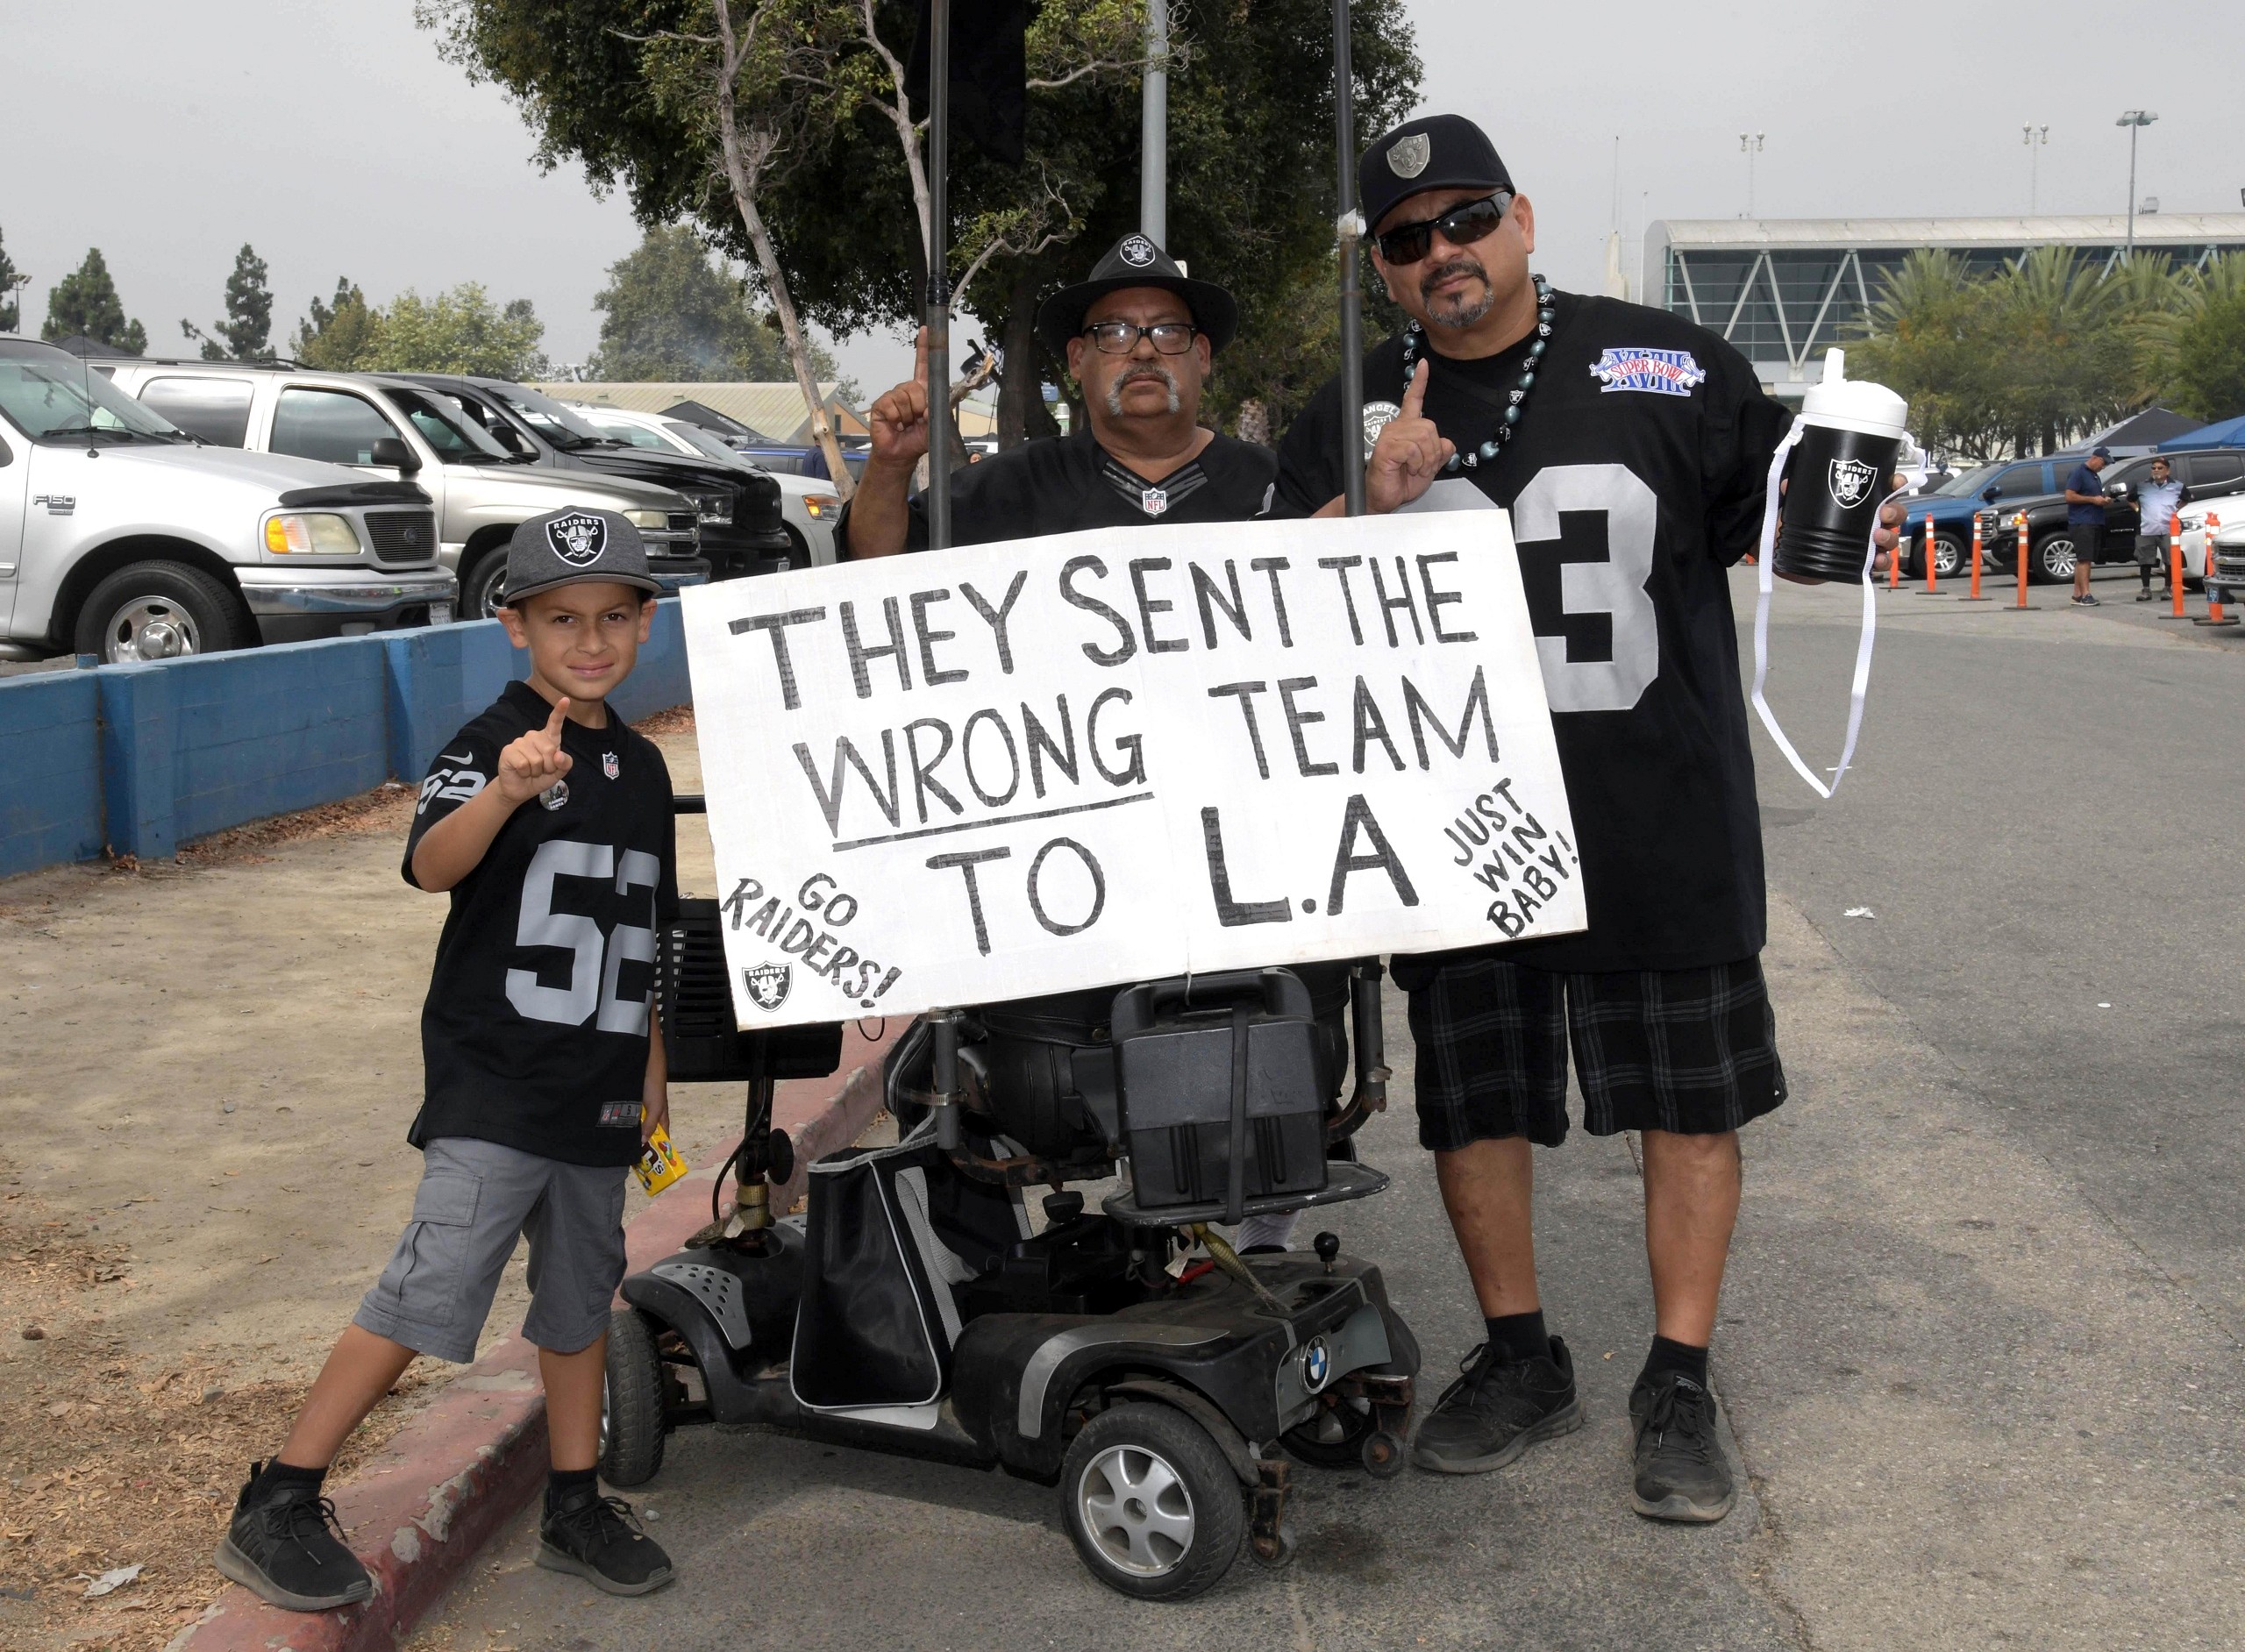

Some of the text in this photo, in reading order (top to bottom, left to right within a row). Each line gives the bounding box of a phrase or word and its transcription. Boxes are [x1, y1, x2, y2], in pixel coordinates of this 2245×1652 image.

[1610, 359, 1686, 383] SUPER BOWL
[1147, 500, 1165, 510] NFL
[1835, 463, 1872, 475] RAIDERS
[553, 518, 600, 530] RAIDERS
[728, 552, 1479, 710] THEY SENT THE
[417, 768, 487, 815] 52
[793, 665, 1500, 838] WRONG TEAM
[1444, 777, 1523, 867] JUST
[1472, 812, 1548, 894] WIN
[799, 872, 859, 927] GO
[926, 794, 1419, 957] TO L.A
[1486, 830, 1579, 938] BABY!
[505, 839, 661, 1037] 52
[721, 877, 902, 1008] RAIDERS!
[748, 967, 786, 977] RAIDERS
